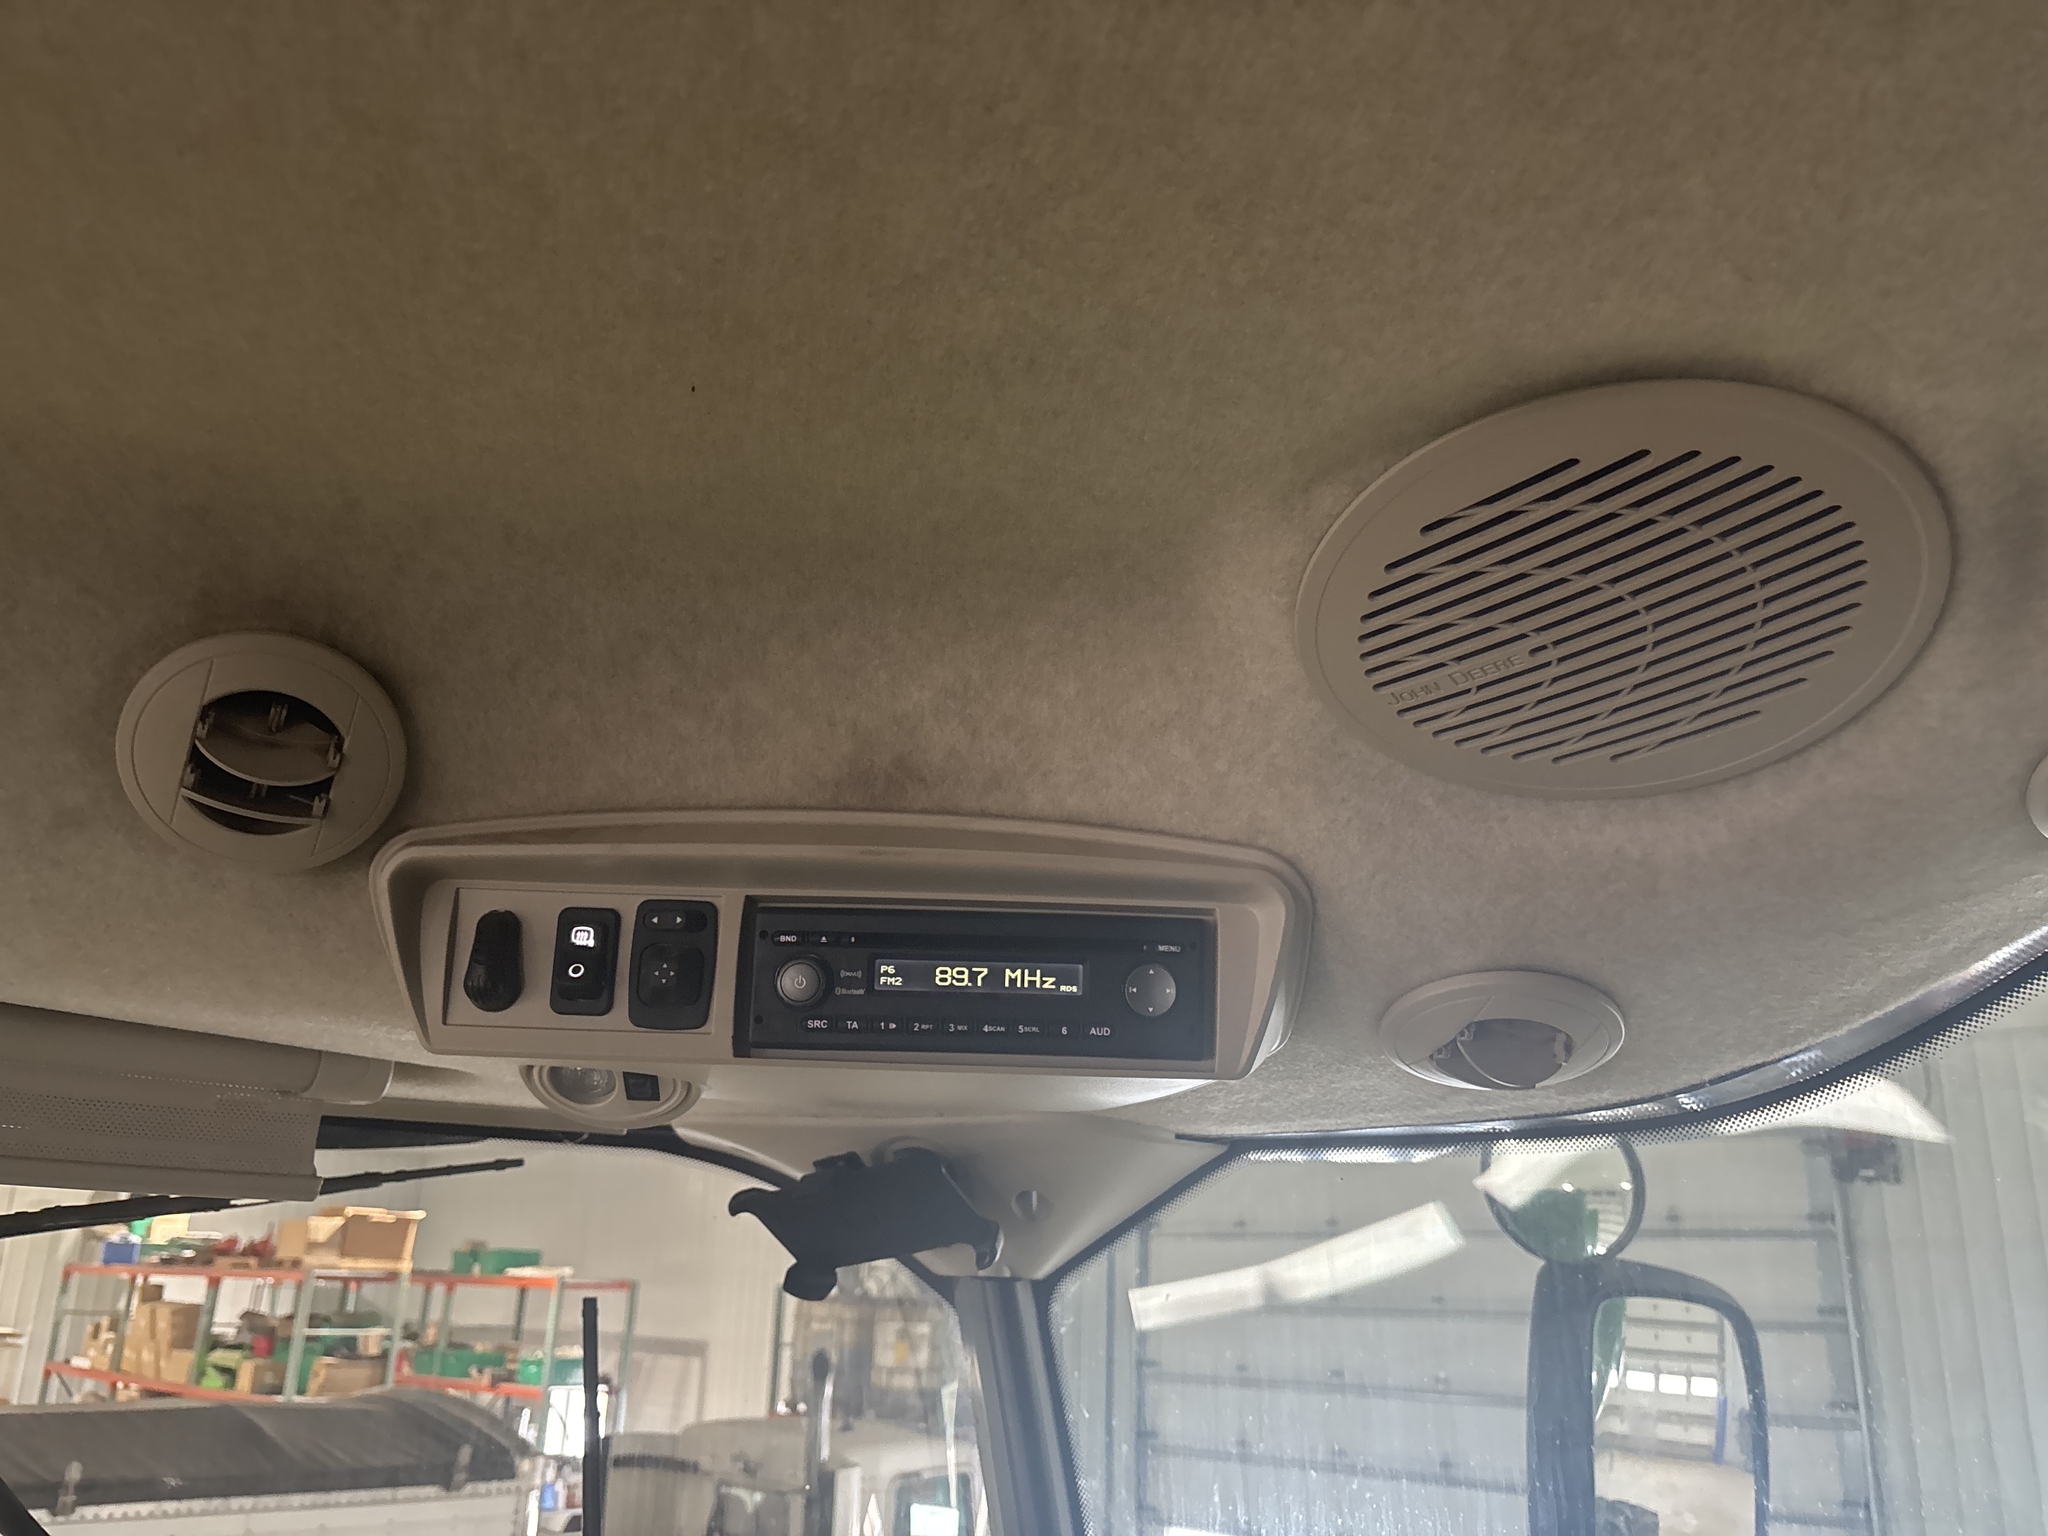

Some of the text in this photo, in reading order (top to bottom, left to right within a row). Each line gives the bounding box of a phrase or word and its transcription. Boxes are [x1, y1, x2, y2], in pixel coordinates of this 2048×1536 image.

[1387, 653, 1526, 706] JOHN DEERE
[779, 935, 798, 943] BND
[1158, 944, 1181, 953] MENU
[880, 965, 896, 974] P6
[879, 976, 903, 986] FM2
[935, 966, 1057, 989] 89.7 MHz
[1059, 985, 1078, 993] RDS
[807, 1019, 828, 1029] SRC
[846, 1020, 859, 1030] TA
[879, 1021, 885, 1030] 1
[1061, 1026, 1068, 1035] 6
[1089, 1026, 1111, 1036] AUD
